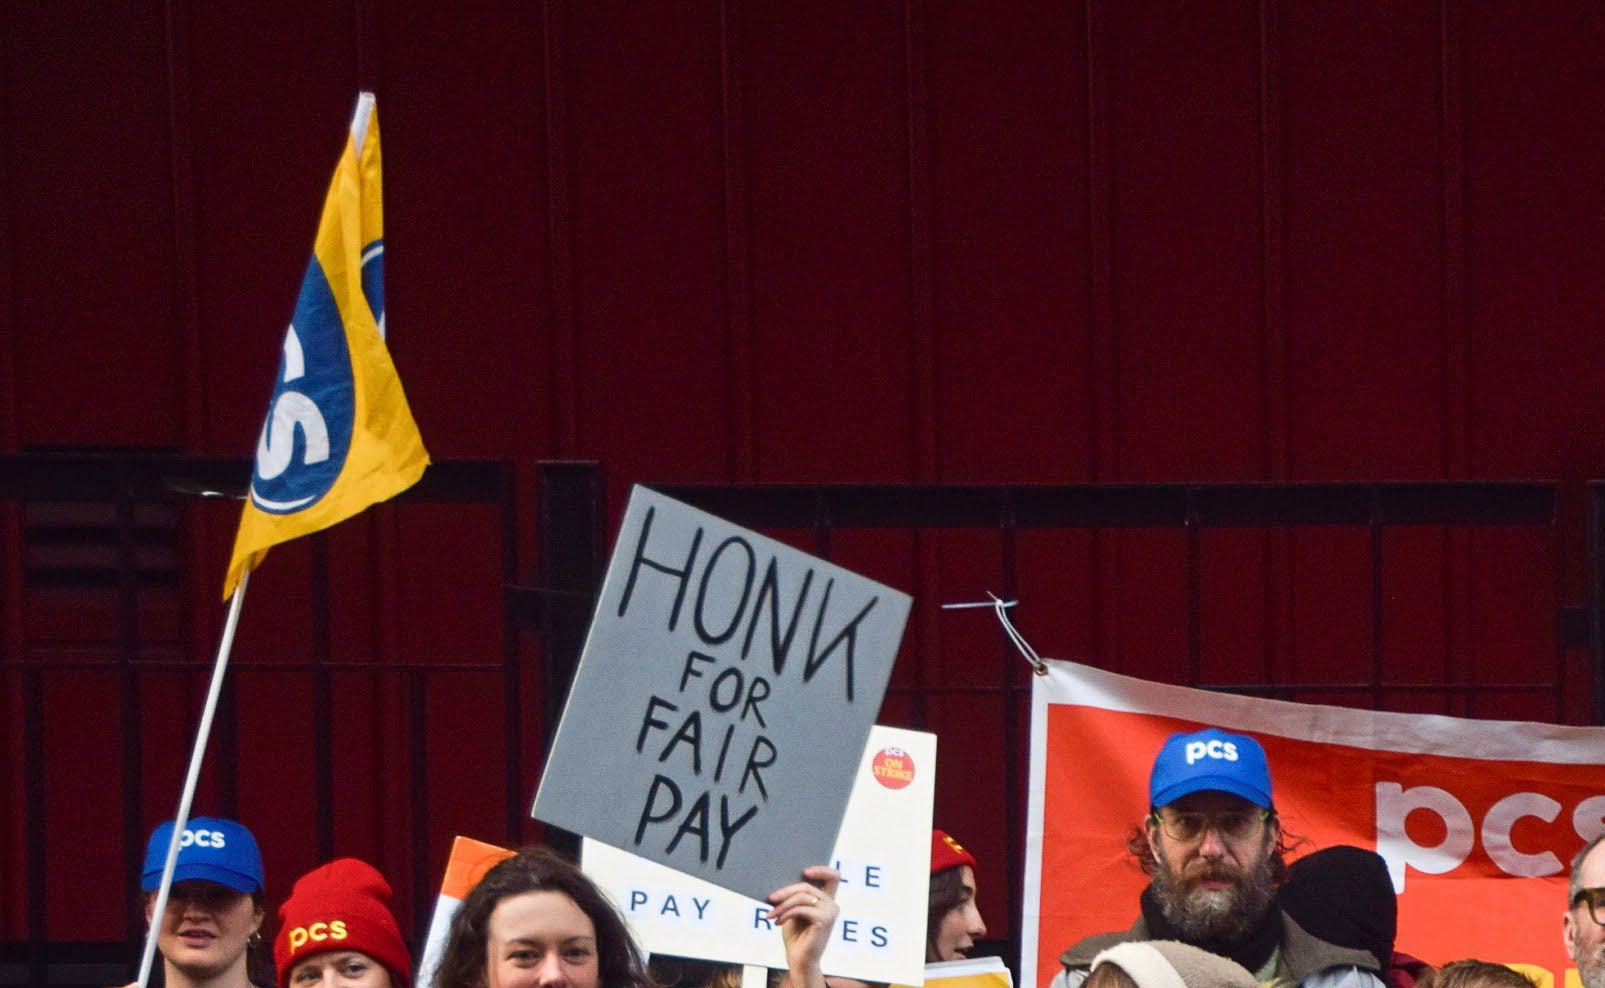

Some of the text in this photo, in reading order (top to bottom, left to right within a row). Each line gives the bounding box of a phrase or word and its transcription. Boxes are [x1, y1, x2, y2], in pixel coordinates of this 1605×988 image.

[617, 506, 880, 704] HONK
[679, 651, 770, 728] FOR
[636, 695, 777, 802] FAIR
[873, 765, 912, 781] STRIKE
[1186, 739, 1239, 765] pcs
[633, 774, 758, 870] PAY
[289, 920, 347, 955] pcs
[630, 890, 890, 948] PAY RES
